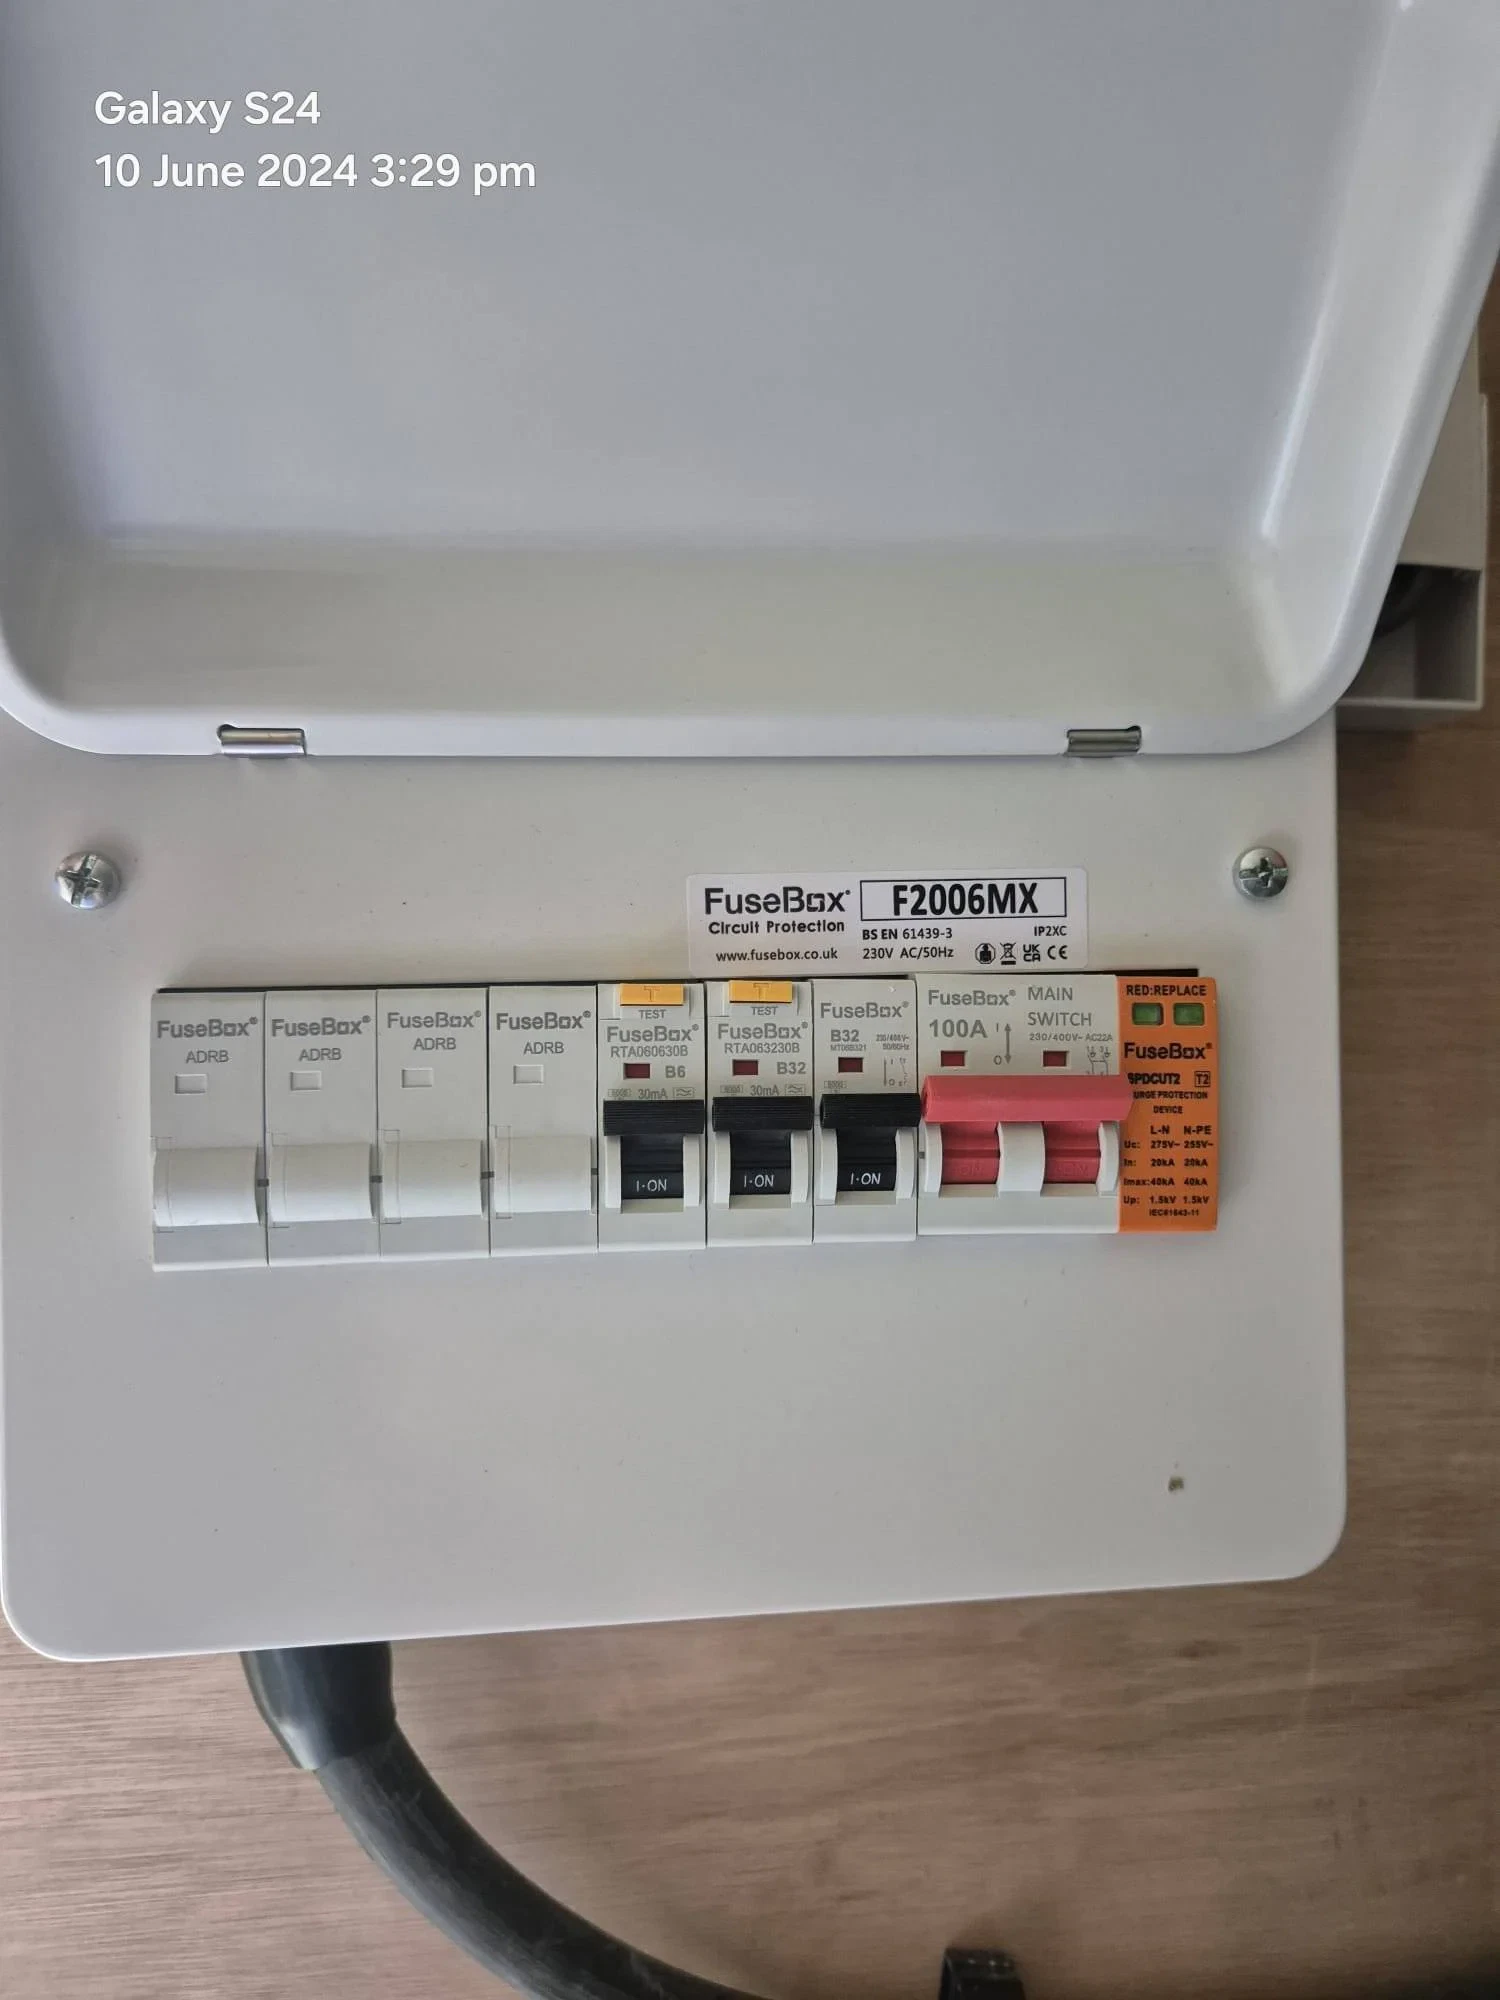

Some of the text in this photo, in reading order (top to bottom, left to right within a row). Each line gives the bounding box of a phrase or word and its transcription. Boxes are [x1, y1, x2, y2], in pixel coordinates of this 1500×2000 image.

[893, 882, 1038, 917] F2006MX
[708, 919, 845, 935] Circuit Protection
[1034, 925, 1067, 937] IP2XC
[862, 928, 953, 940] BS EN 61439-3
[715, 947, 838, 962] www.fusebox.co.uk
[862, 946, 954, 960] 230V AC/50Hz
[1027, 987, 1073, 1001] MAIN
[1126, 984, 1207, 997] RED:REPLACE
[639, 1009, 666, 1019] TEST
[751, 1006, 778, 1015] TEST
[1027, 1012, 1092, 1027] SWITCH
[929, 1019, 988, 1039] 100A
[830, 1029, 860, 1043] B32
[1085, 1033, 1113, 1042] AC22A
[413, 1037, 457, 1051] ADRB
[523, 1042, 565, 1055] ADRB
[724, 1042, 800, 1054] RTA063230B
[185, 1050, 229, 1064] ADRB
[299, 1048, 342, 1062] ADRB
[610, 1045, 689, 1058] RTA060630B
[665, 1065, 686, 1079] B6
[776, 1061, 807, 1075] B32
[1196, 1073, 1209, 1085] T2
[637, 1088, 668, 1100] 30mA
[750, 1084, 779, 1097] 30mA
[1157, 1090, 1208, 1100] PROTECTION
[1153, 1105, 1183, 1114] DEVICE
[1150, 1125, 1212, 1135] L-N N-PE
[1151, 1158, 1175, 1167] 20kA
[1151, 1177, 1175, 1186] 40kA
[1183, 1177, 1208, 1186] 40kA
[1123, 1195, 1209, 1206] Up: 1.5kV 1.5kV
